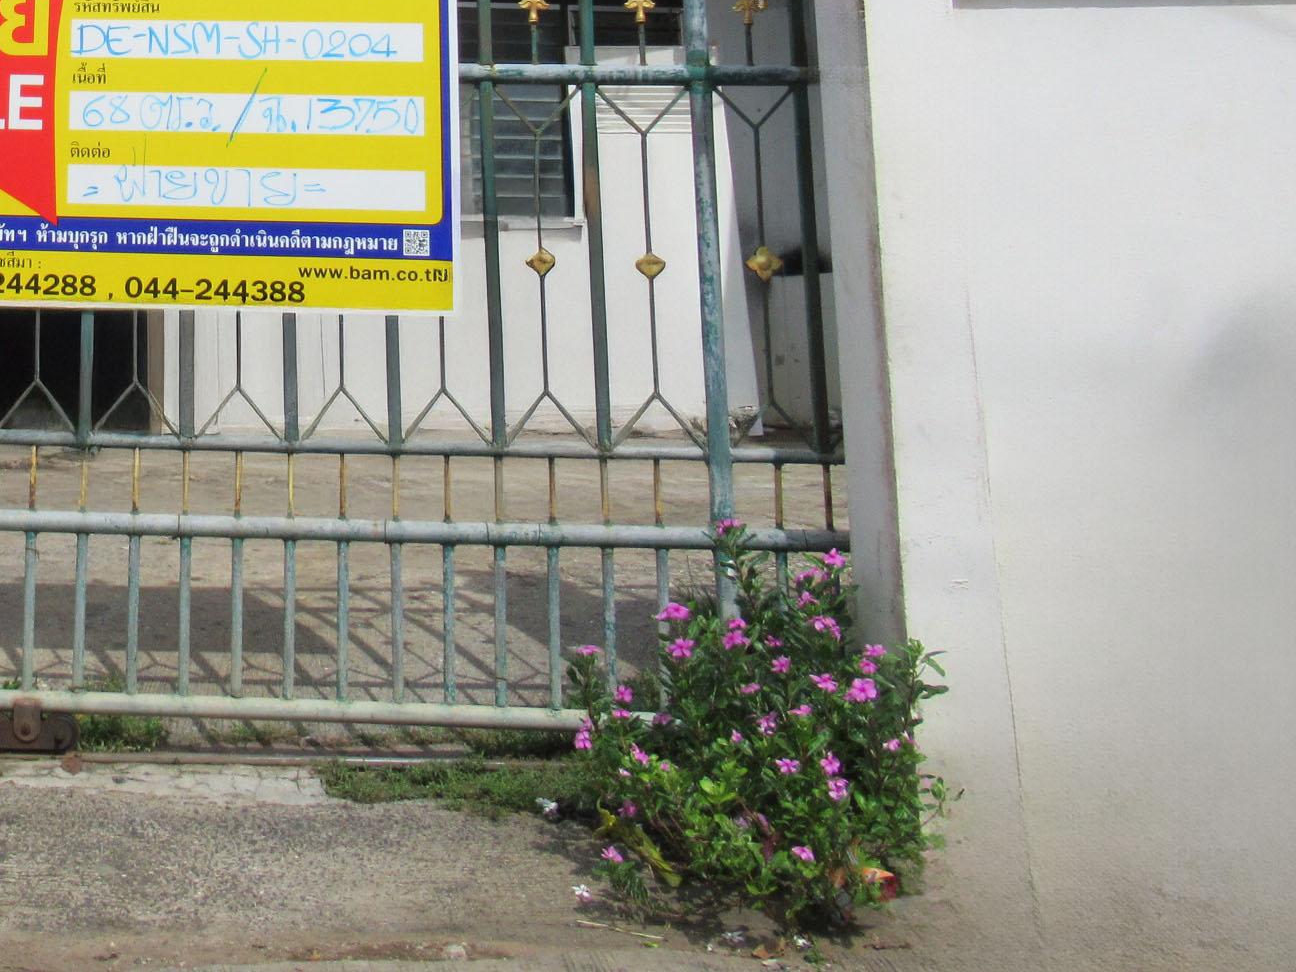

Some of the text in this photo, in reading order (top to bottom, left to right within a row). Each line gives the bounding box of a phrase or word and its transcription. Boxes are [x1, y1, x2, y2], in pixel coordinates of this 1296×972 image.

[70, 22, 398, 59] DE-NSM-SH-0204
[72, 61, 107, 85] เนื้อที่
[82, 94, 131, 127] 68
[70, 142, 111, 159] ติดต่อ
[35, 224, 108, 250] ห้ามบุกรุก
[124, 276, 306, 303] 044-244388
